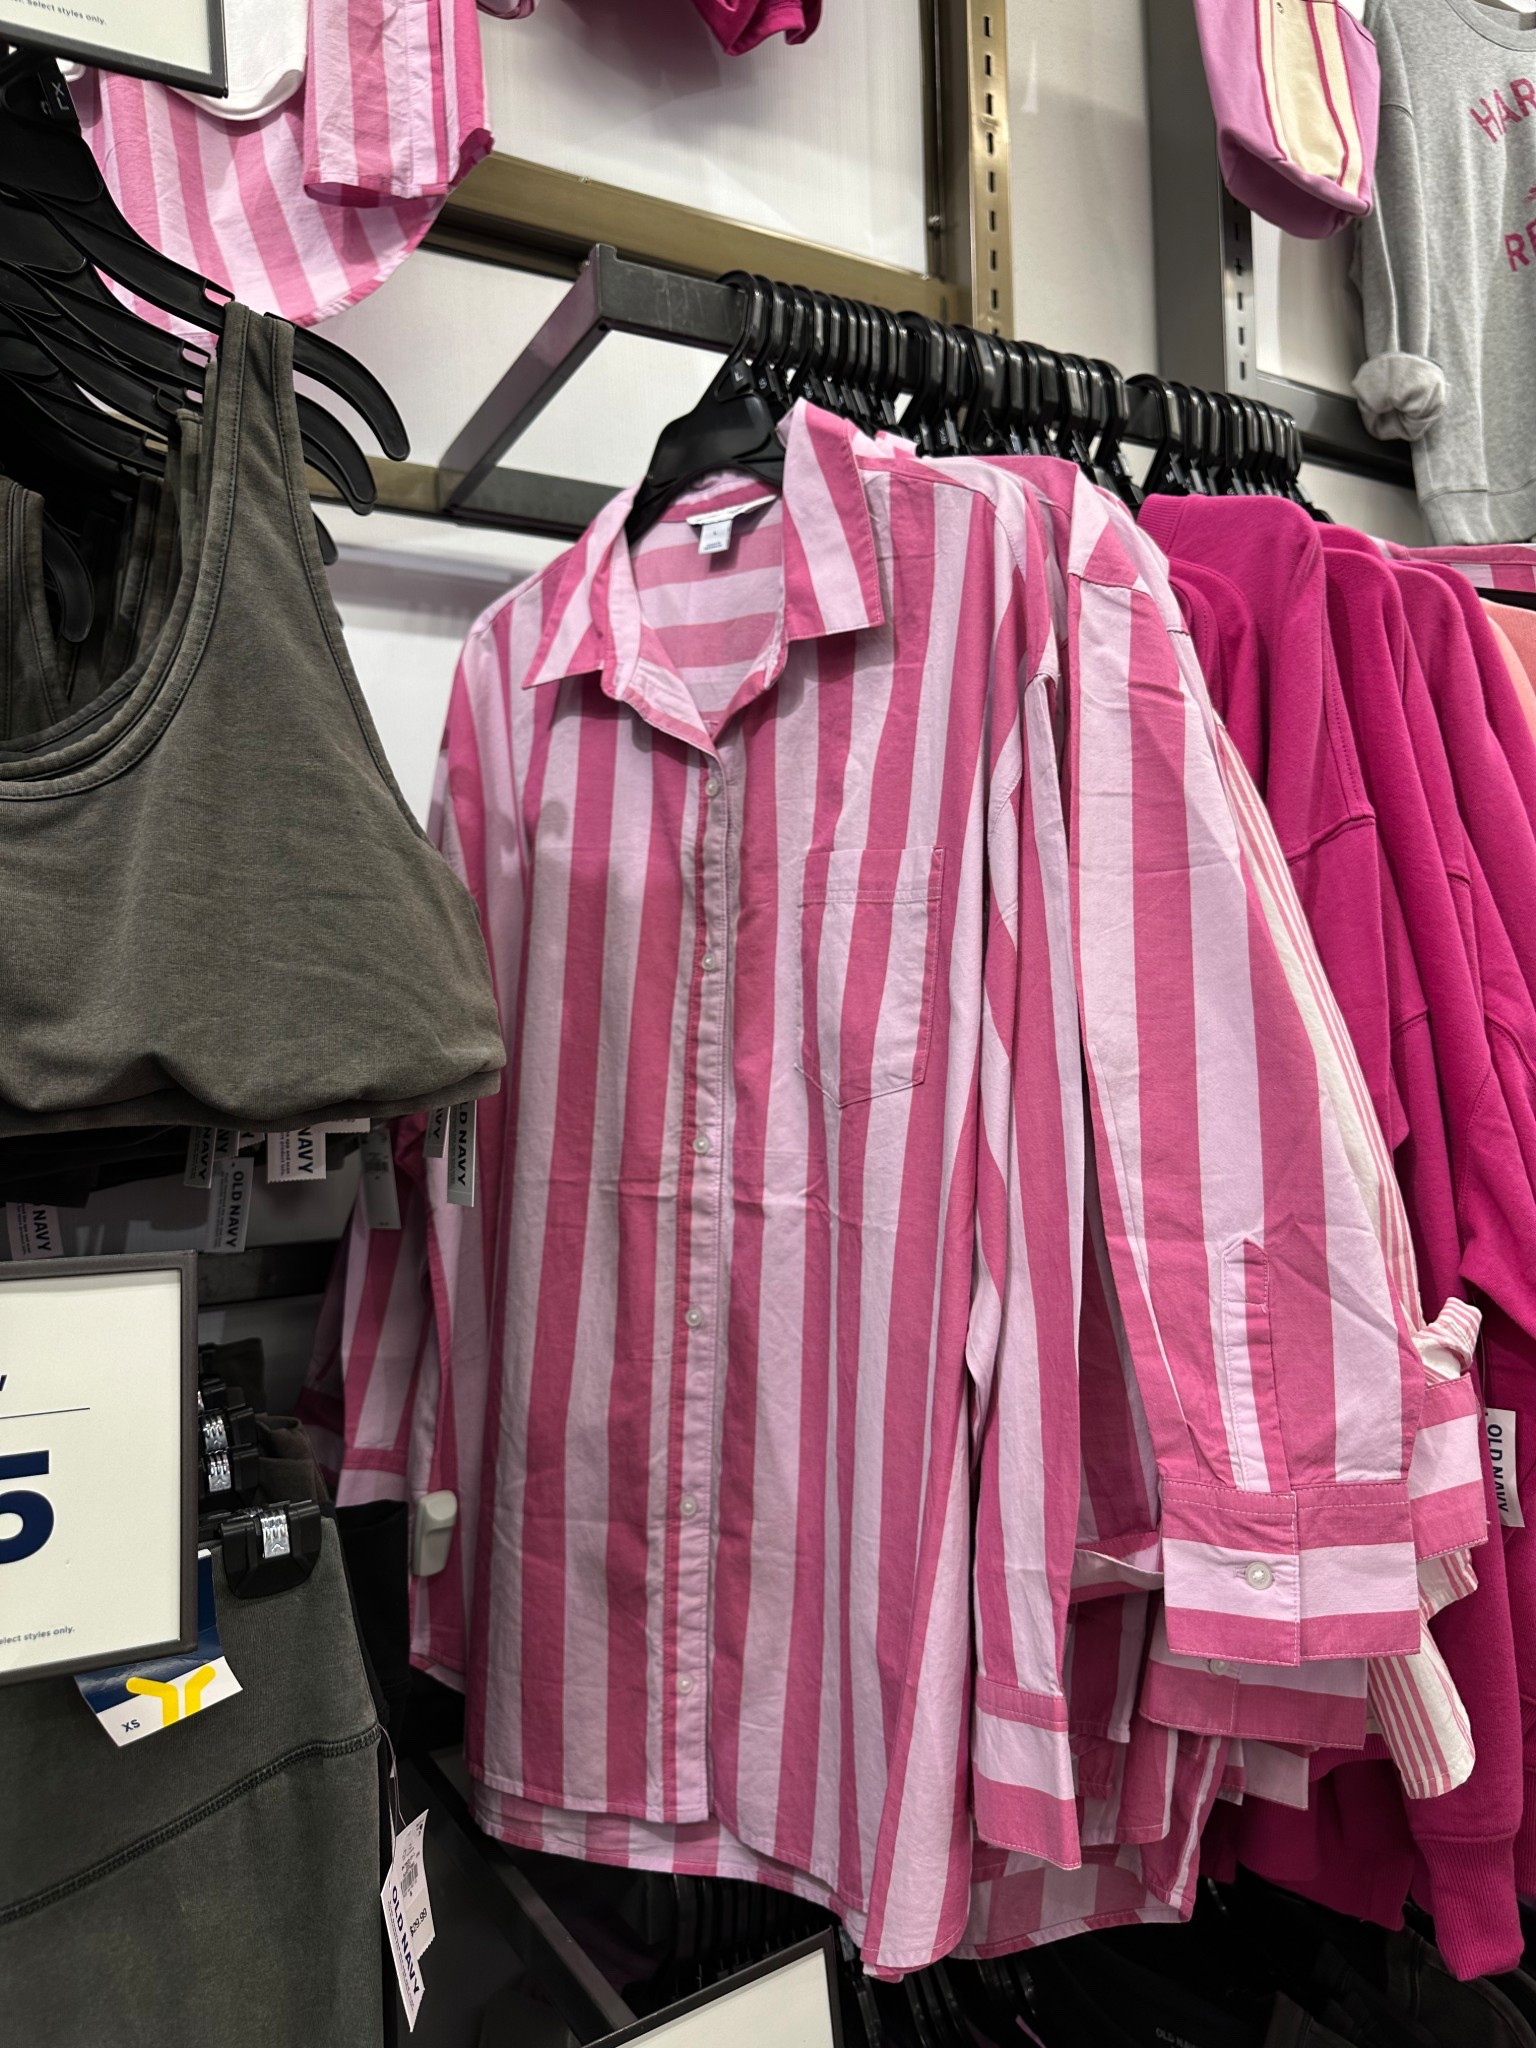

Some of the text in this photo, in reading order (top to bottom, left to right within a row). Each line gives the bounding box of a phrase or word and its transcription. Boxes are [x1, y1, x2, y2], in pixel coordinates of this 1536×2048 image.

[57, 7, 84, 19] styles
[85, 14, 107, 25] only.
[298, 1127, 313, 1174] NAVY
[457, 1129, 467, 1187] NAVY
[33, 1209, 52, 1251] NAVY
[226, 1171, 244, 1248] OLD NAVY
[1487, 1424, 1503, 1461] OLD
[24, 1630, 51, 1641] styles
[53, 1626, 75, 1635] only.
[121, 1719, 141, 1733] XS
[392, 1885, 404, 1931] OLD
[401, 1932, 420, 1994] NAVY
